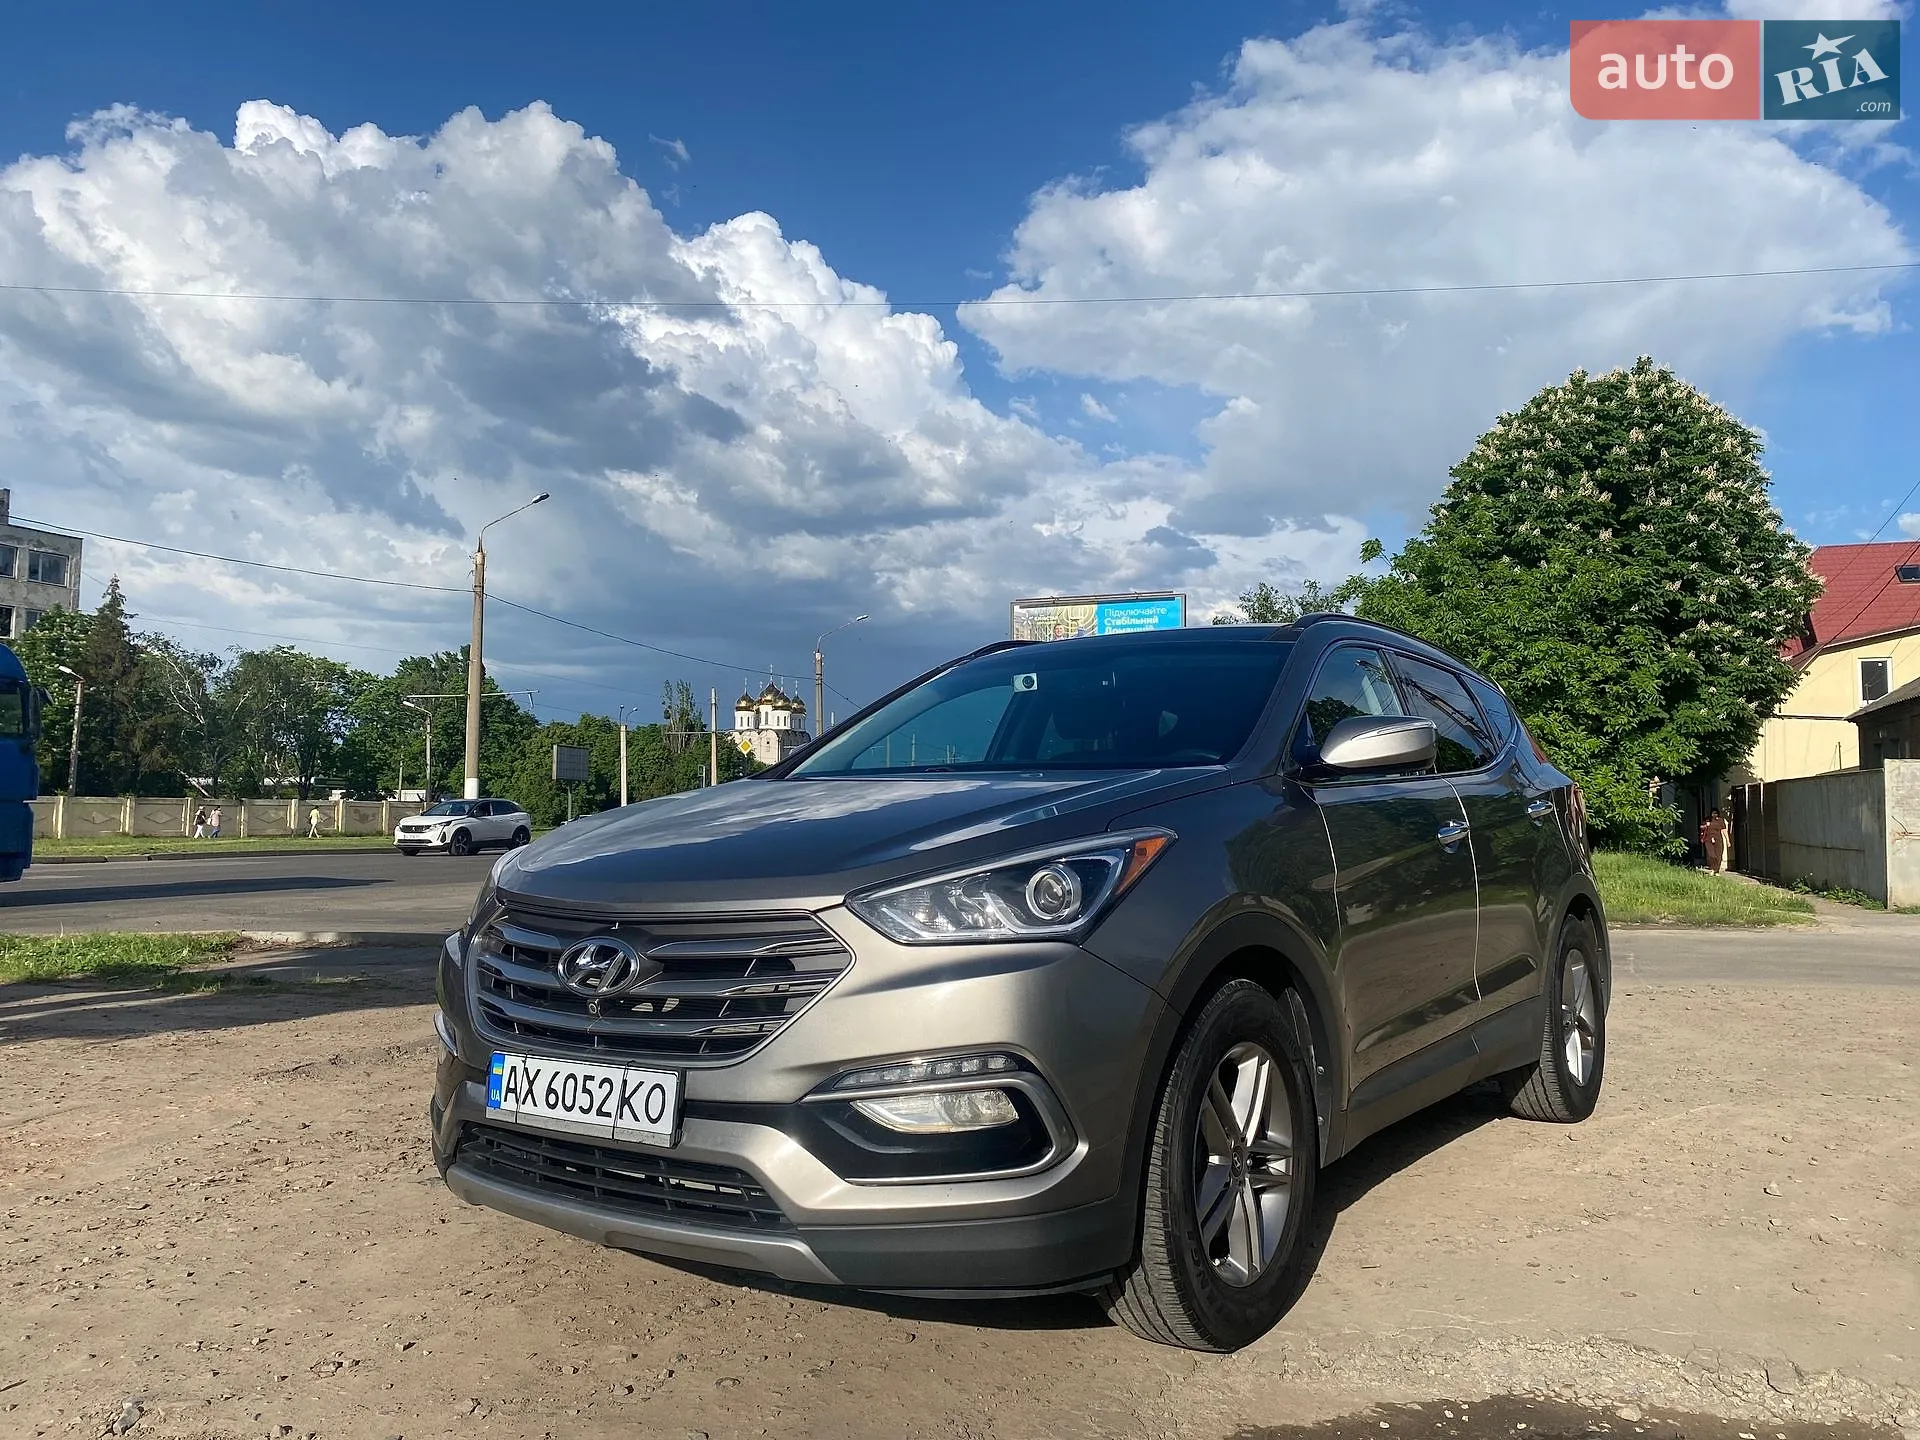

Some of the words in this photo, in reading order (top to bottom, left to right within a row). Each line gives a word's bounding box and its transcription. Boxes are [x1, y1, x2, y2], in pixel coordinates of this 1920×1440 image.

[1104, 607, 1168, 618] Підключайте
[1104, 615, 1159, 626] Стабільний
[490, 1089, 501, 1101] UA
[503, 1065, 542, 1107] AX
[545, 1071, 614, 1118] 6052
[619, 1079, 666, 1125] KO
